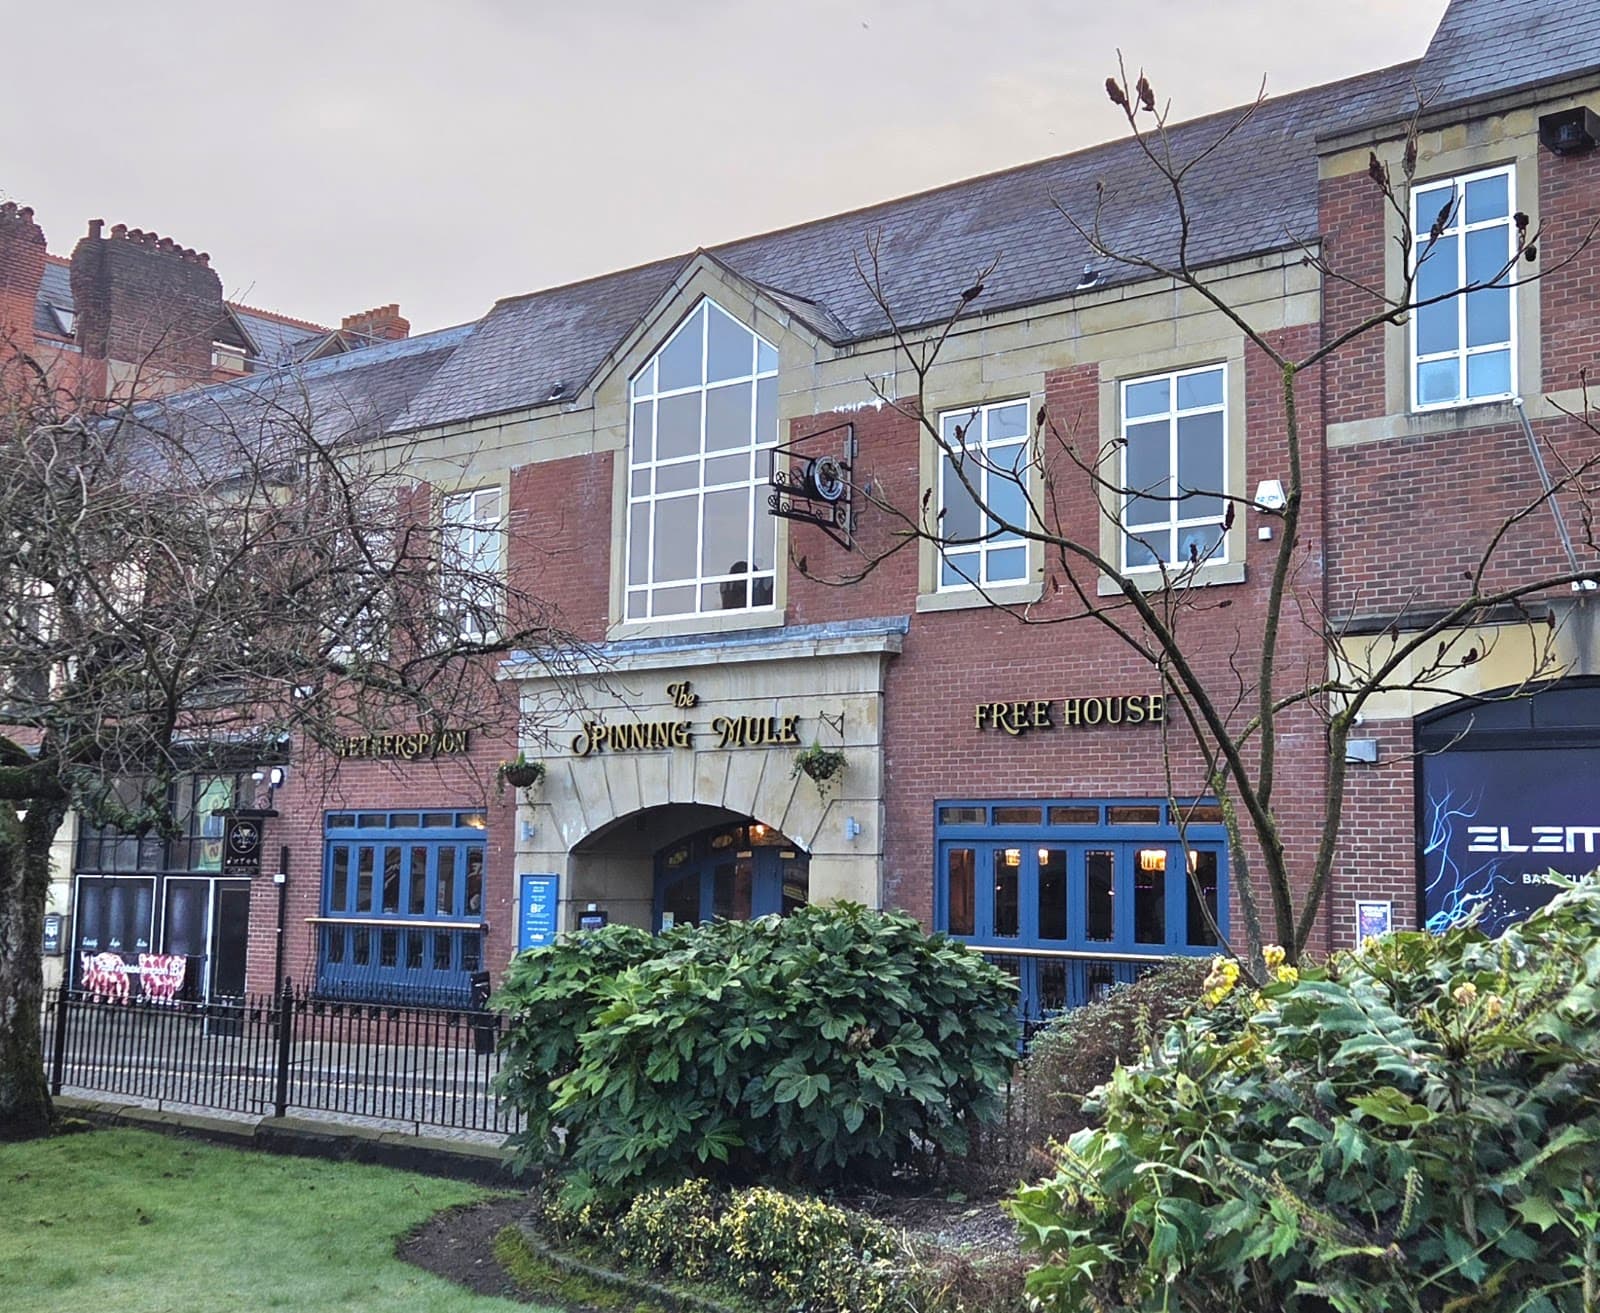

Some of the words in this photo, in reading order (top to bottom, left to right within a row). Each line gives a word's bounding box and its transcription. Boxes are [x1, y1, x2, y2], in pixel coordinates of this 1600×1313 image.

[667, 681, 697, 708] The
[572, 720, 691, 756] SPINNING
[712, 714, 801, 749] MULE
[974, 701, 1050, 735] FREE
[1064, 695, 1165, 726] HOUSE
